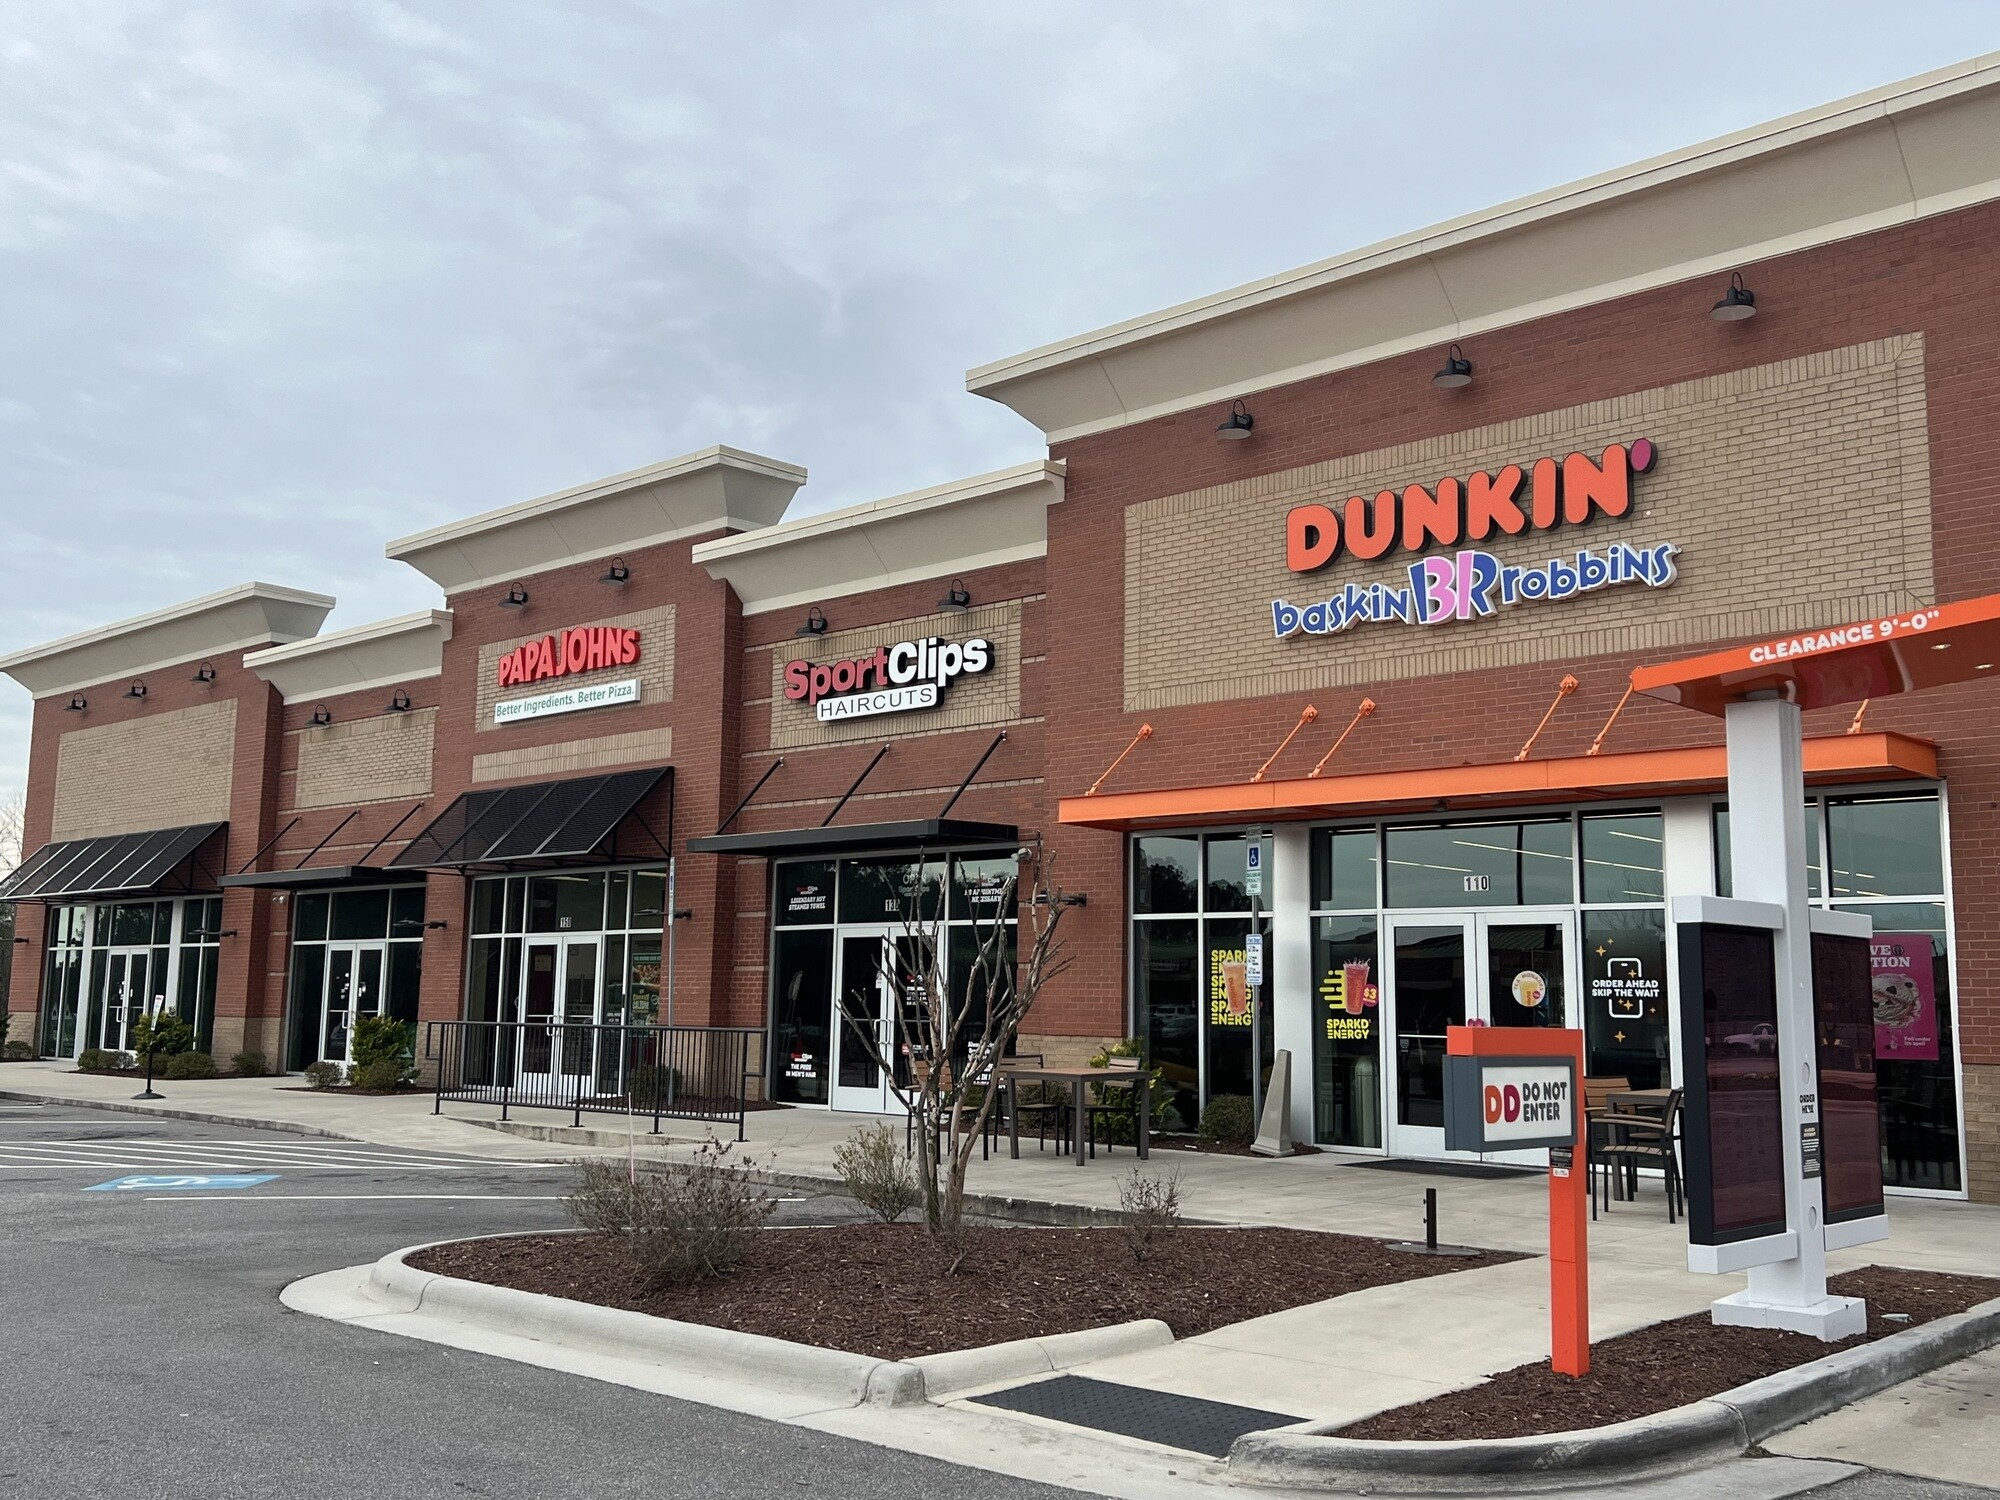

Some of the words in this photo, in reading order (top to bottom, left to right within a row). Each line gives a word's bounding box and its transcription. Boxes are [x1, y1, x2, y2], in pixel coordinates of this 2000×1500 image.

[1286, 438, 1655, 572] DUNKIN'
[1749, 623, 1875, 663] CLEARANCE
[498, 635, 554, 687] PAPA
[555, 627, 639, 676] JOHNS
[496, 703, 523, 717] Better
[523, 693, 576, 714] Ingredients.
[578, 690, 606, 704] Better
[608, 684, 635, 698] Pizza.
[820, 687, 933, 718] HAIRCUTS
[1466, 876, 1488, 891] 110
[1363, 987, 1377, 1000] $3
[1591, 988, 1613, 997] SKIP
[1614, 989, 1633, 997] THE
[1634, 989, 1660, 998] WAIT
[1592, 979, 1624, 988] ORDER
[1625, 979, 1659, 988] AHEAD
[1327, 1029, 1370, 1040] ENERGY
[1485, 1084, 1521, 1124] DD
[1522, 1083, 1541, 1102] DO
[1543, 1081, 1568, 1101] NOT
[1799, 1093, 1815, 1103] ORDER
[1523, 1102, 1561, 1122] ENTER
